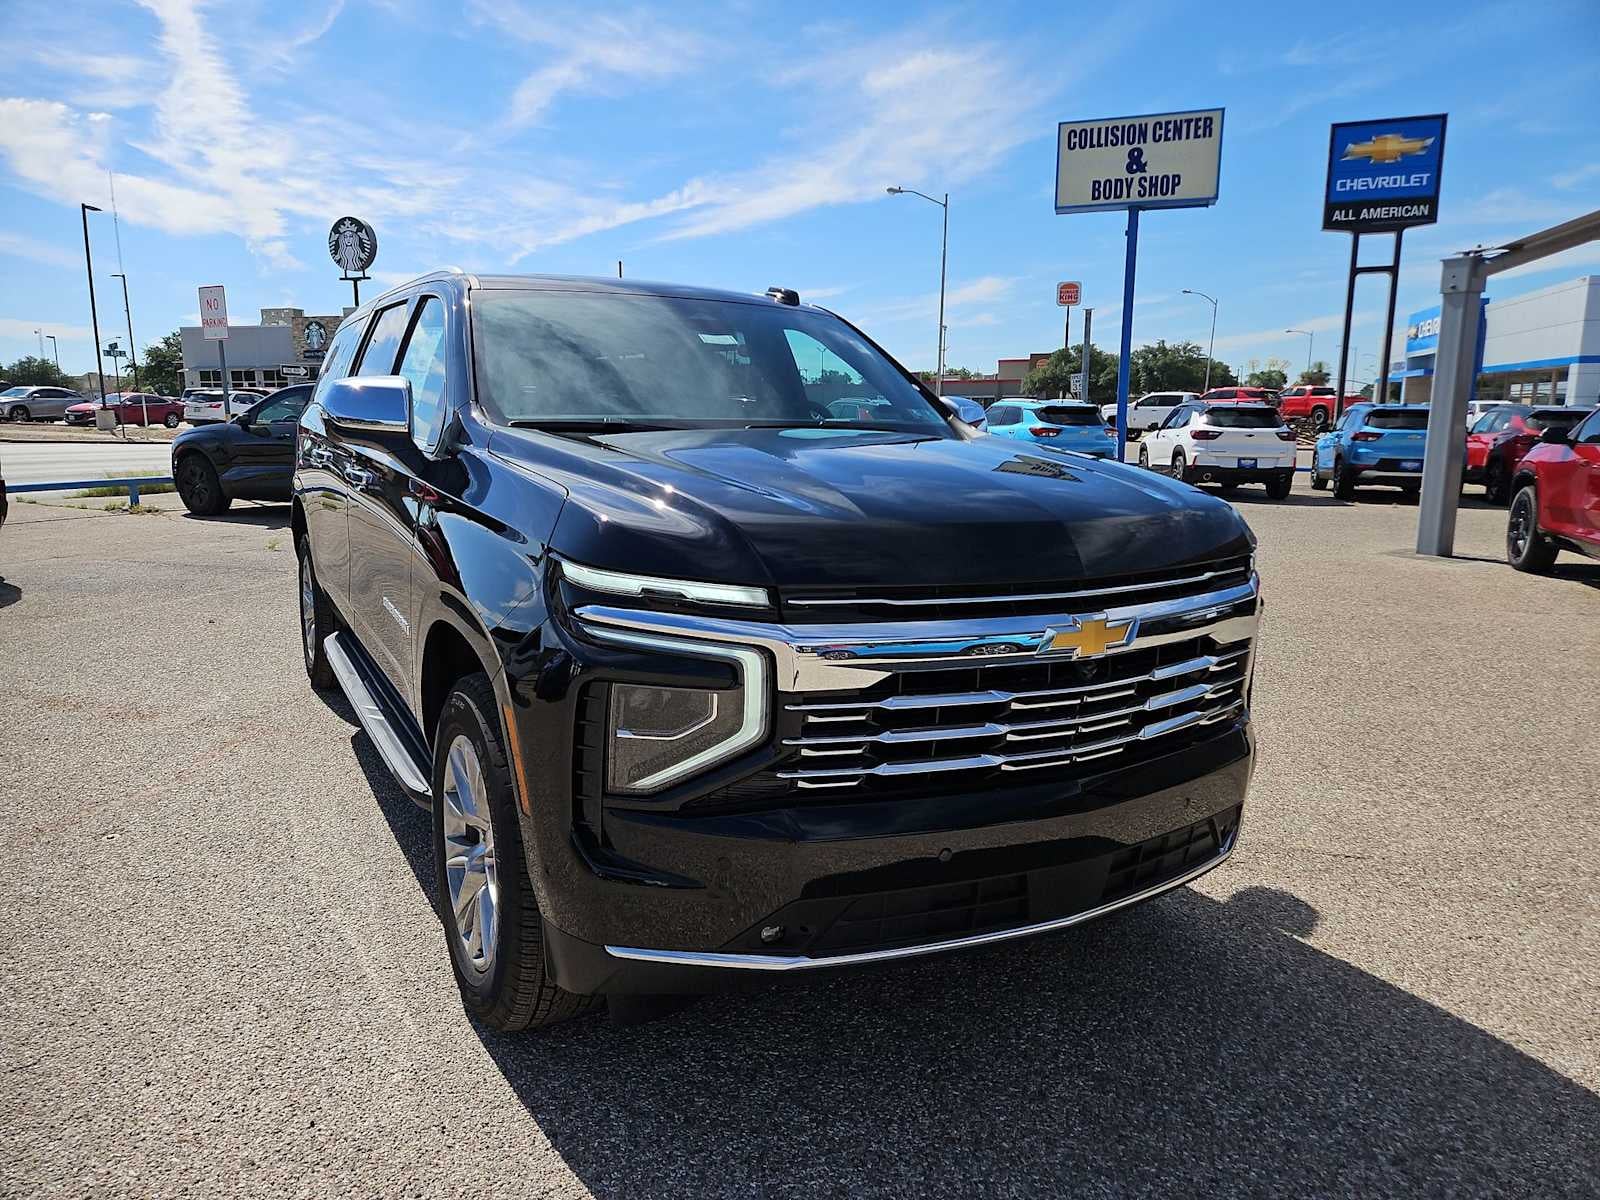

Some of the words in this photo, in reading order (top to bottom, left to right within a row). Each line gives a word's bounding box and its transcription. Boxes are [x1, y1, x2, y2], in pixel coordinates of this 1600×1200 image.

[1067, 122, 1148, 151] COLLISION
[1152, 116, 1213, 143] CENTER
[1126, 147, 1147, 174] &
[1091, 177, 1134, 201] BODY
[1137, 174, 1181, 197] SHOP
[1336, 173, 1431, 192] CHEVROLET
[1332, 209, 1356, 222] ALL
[1360, 204, 1430, 220] AMERICAN
[206, 298, 219, 310] NO
[202, 317, 227, 328] PARKING
